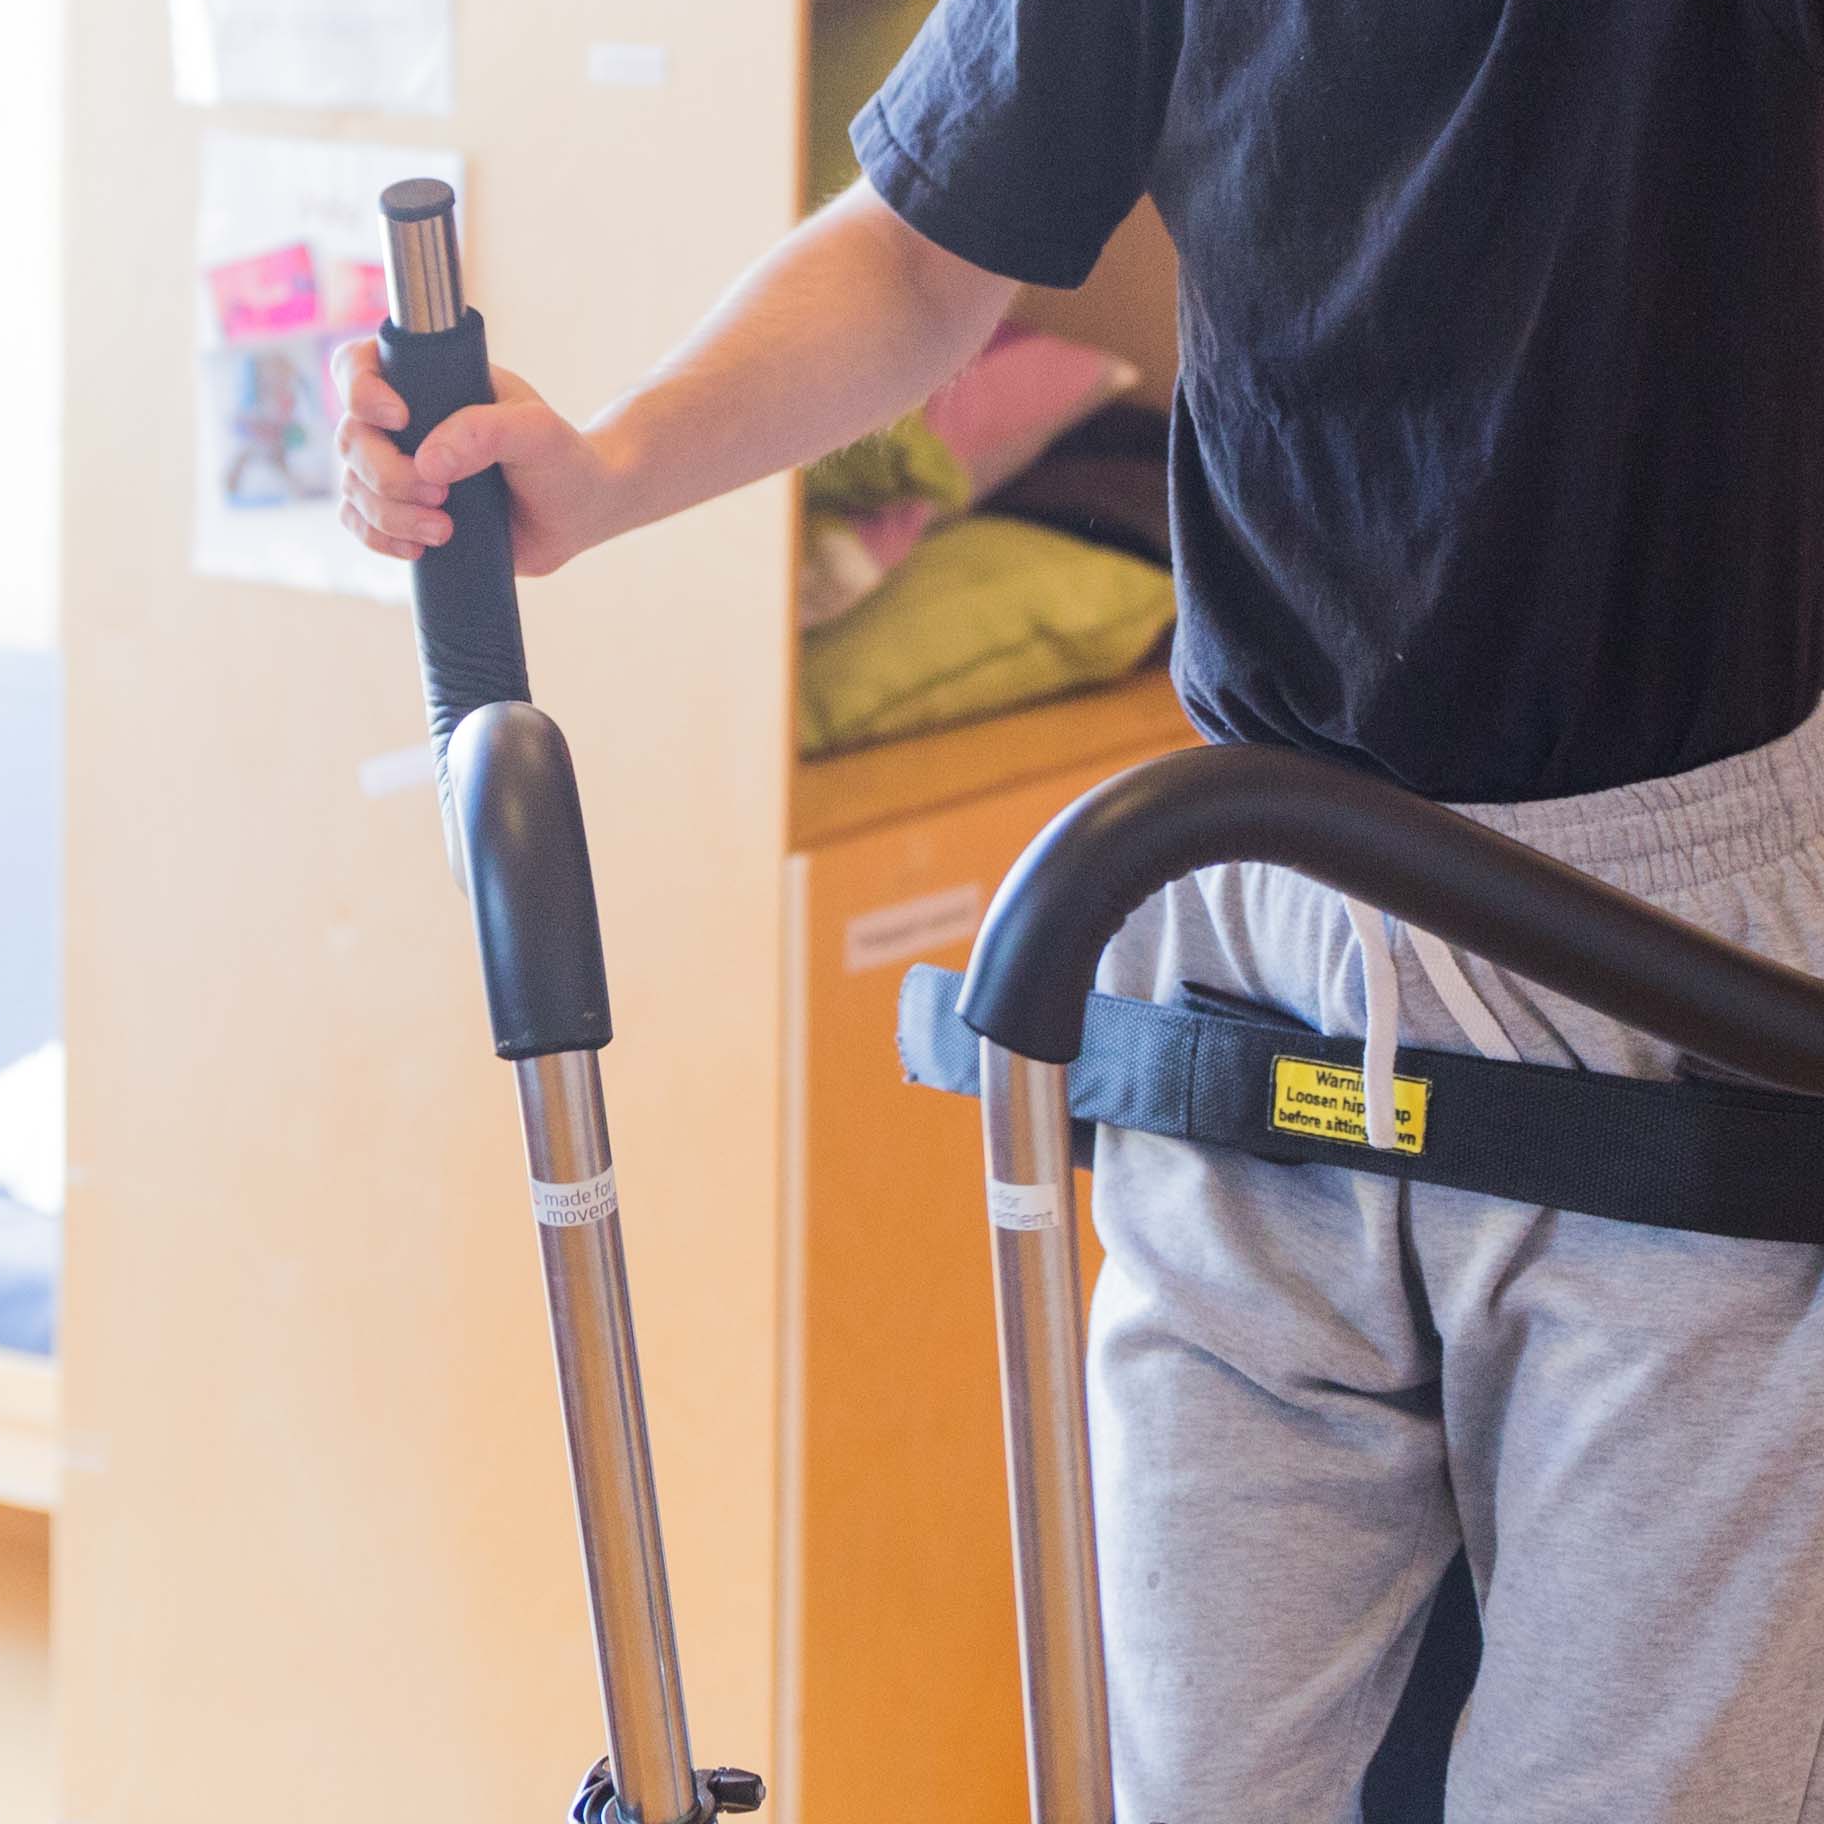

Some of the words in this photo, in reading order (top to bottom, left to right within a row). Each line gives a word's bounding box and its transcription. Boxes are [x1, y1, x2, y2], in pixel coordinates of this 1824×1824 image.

[1316, 1071, 1364, 1092] Warni
[1287, 1087, 1338, 1110] Loosen
[1279, 1108, 1321, 1128] before
[544, 1188, 591, 1207] made
[595, 1178, 612, 1198] for
